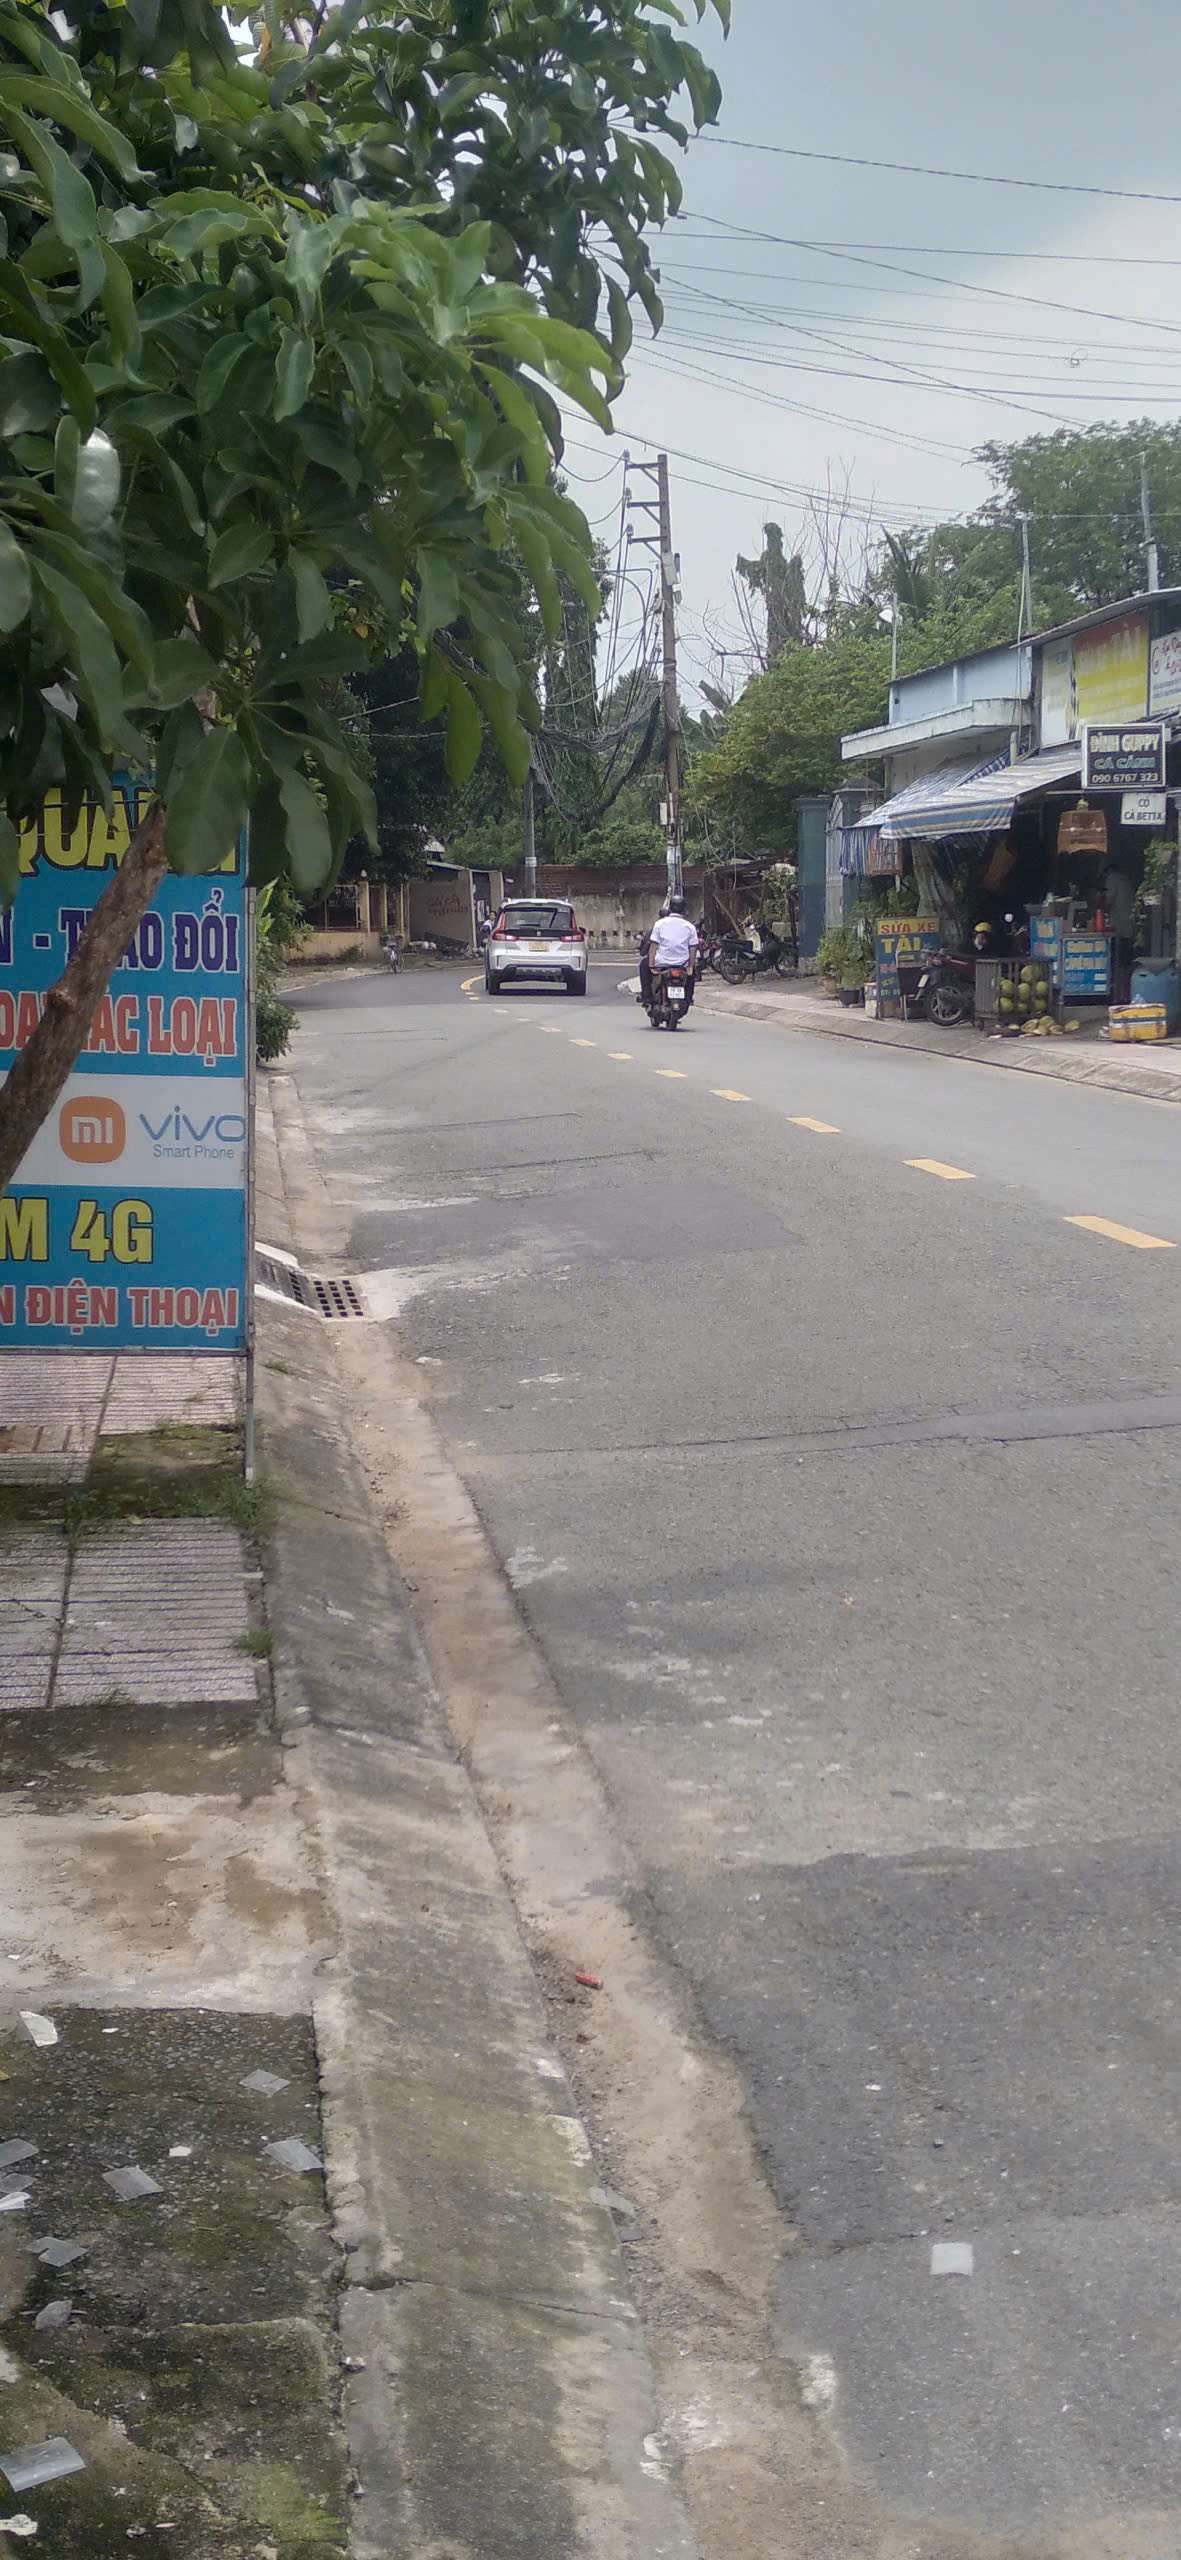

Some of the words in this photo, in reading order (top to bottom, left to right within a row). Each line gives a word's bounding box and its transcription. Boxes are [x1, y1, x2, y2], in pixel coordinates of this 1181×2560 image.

[1121, 733, 1160, 752] GUPPY
[1092, 774, 1111, 783] 090
[1113, 773, 1137, 783] 6767
[1139, 772, 1158, 782] 323
[1137, 811, 1162, 821] BETTA
[173, 888, 240, 973] ĐỔI
[917, 921, 936, 932] XE
[147, 995, 237, 1067] LOẠI
[139, 1105, 246, 1142] vivo
[153, 1144, 192, 1158] Smart
[194, 1144, 234, 1158] Phone
[69, 1198, 154, 1264] 4G
[25, 1277, 118, 1335] ĐIỆN
[128, 1287, 239, 1337] THOẠI
